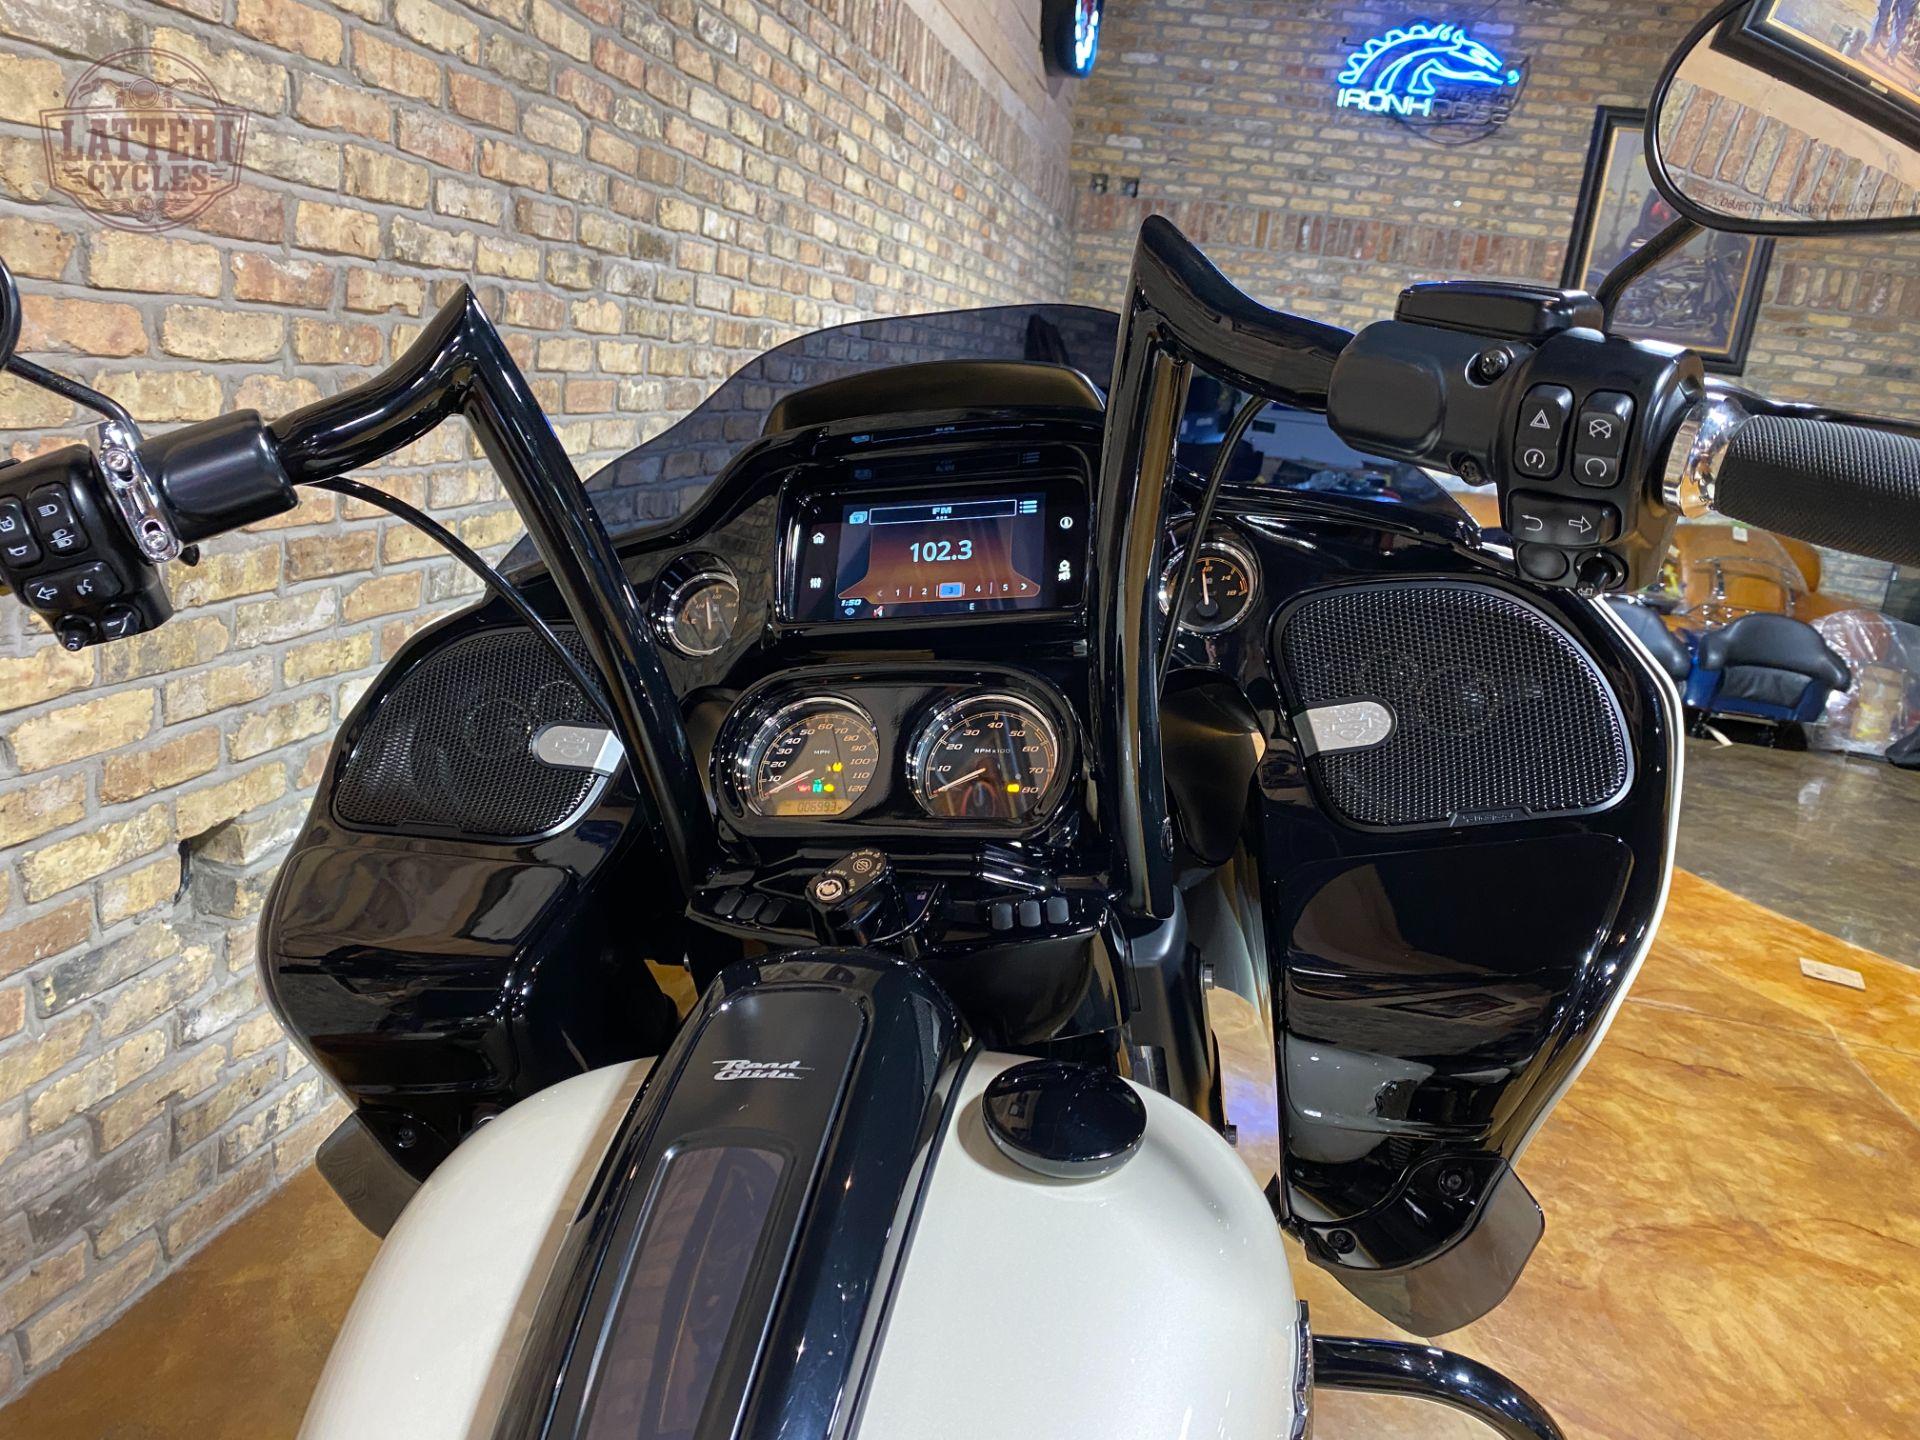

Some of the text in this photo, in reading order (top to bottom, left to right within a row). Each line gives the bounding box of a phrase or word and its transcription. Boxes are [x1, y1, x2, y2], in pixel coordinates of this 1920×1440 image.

[1719, 196, 1764, 213] OBJECTS
[931, 506, 953, 515] FM
[909, 539, 973, 563] 102.3
[799, 728, 816, 736] 50
[784, 737, 802, 745] 40
[843, 734, 860, 742] 80
[1022, 745, 1040, 753] 60
[847, 784, 868, 792] 120
[712, 1059, 808, 1071] Road
